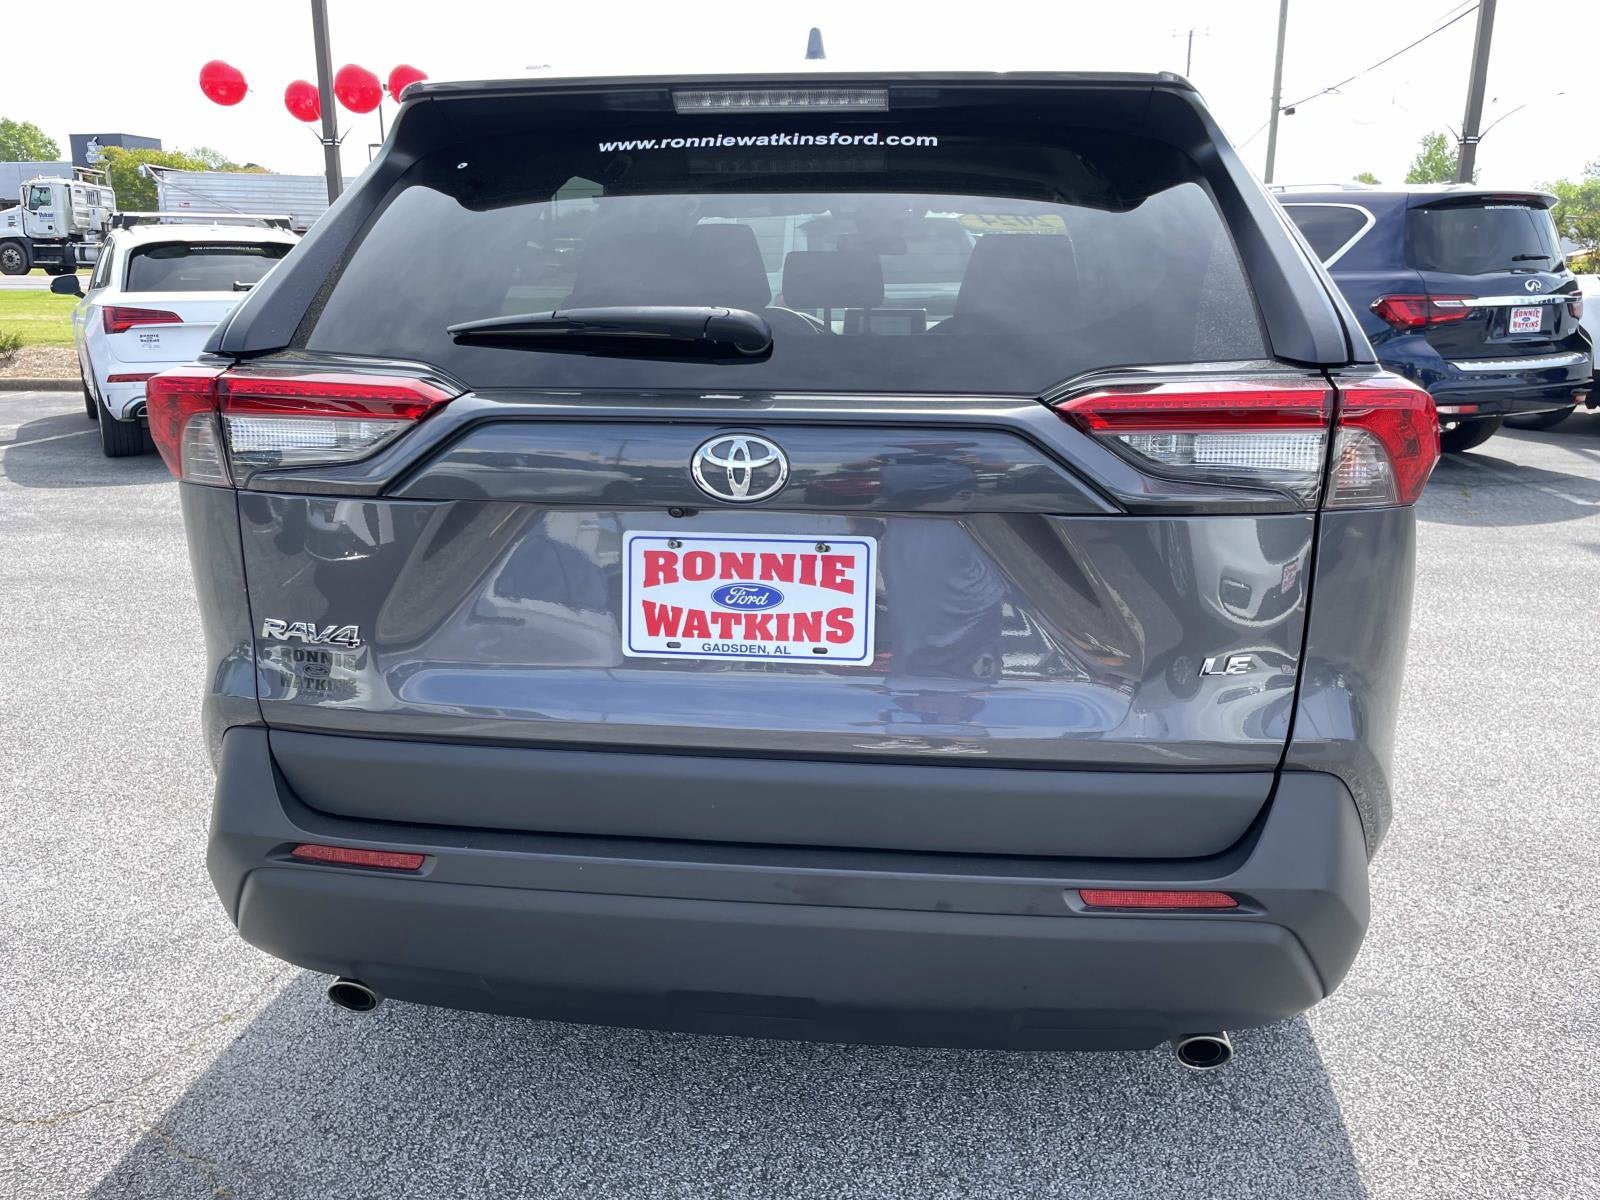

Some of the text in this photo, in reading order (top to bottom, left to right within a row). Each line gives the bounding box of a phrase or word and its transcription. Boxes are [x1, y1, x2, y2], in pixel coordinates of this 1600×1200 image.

[598, 132, 938, 152] www.ronniewatkinsford.com
[643, 550, 856, 595] RONNIE
[725, 587, 769, 605] Ford
[642, 600, 855, 644] WATKINS
[262, 618, 361, 648] RAV4
[702, 643, 791, 655] GADSDEN, AL
[1199, 656, 1252, 677] LE
